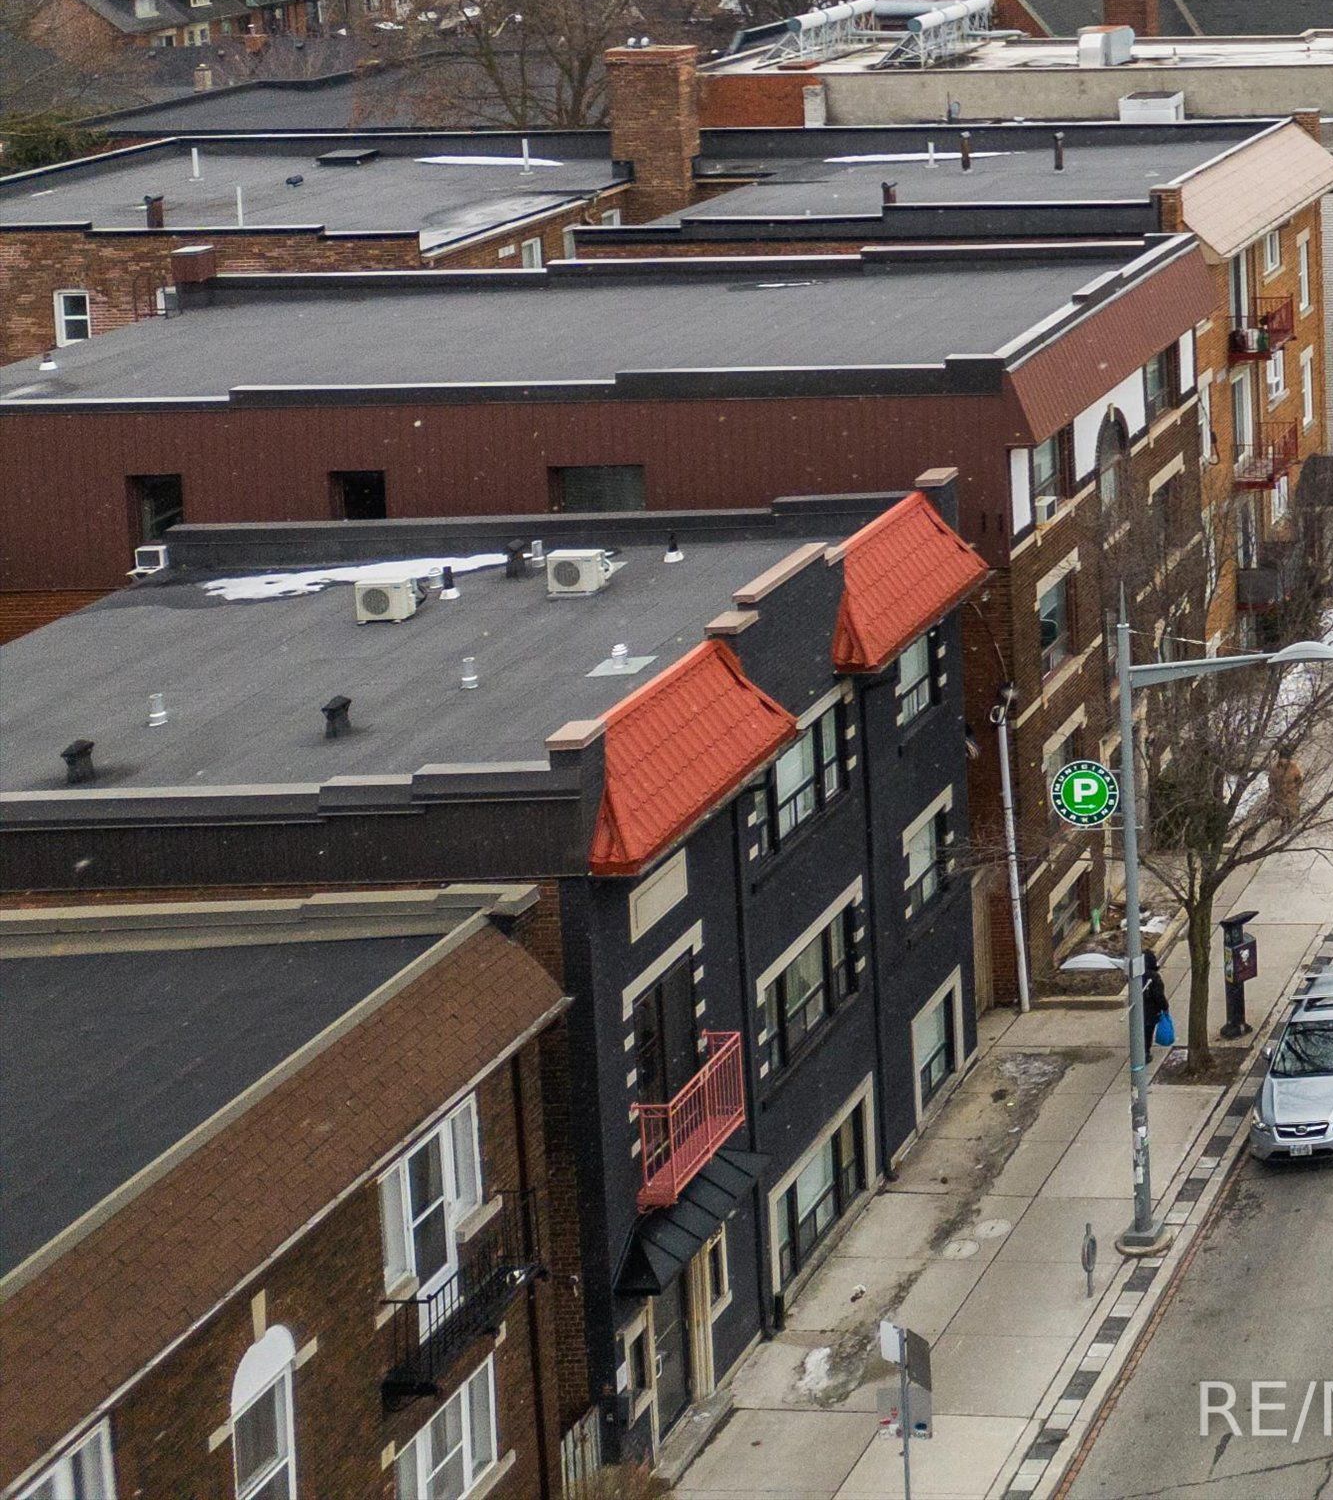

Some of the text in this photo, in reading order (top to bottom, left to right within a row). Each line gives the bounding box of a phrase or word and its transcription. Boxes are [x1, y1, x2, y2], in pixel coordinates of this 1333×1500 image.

[1054, 764, 1115, 792] MUNICIPAL
[1073, 778, 1099, 803] P
[1055, 798, 1115, 823] PARKING
